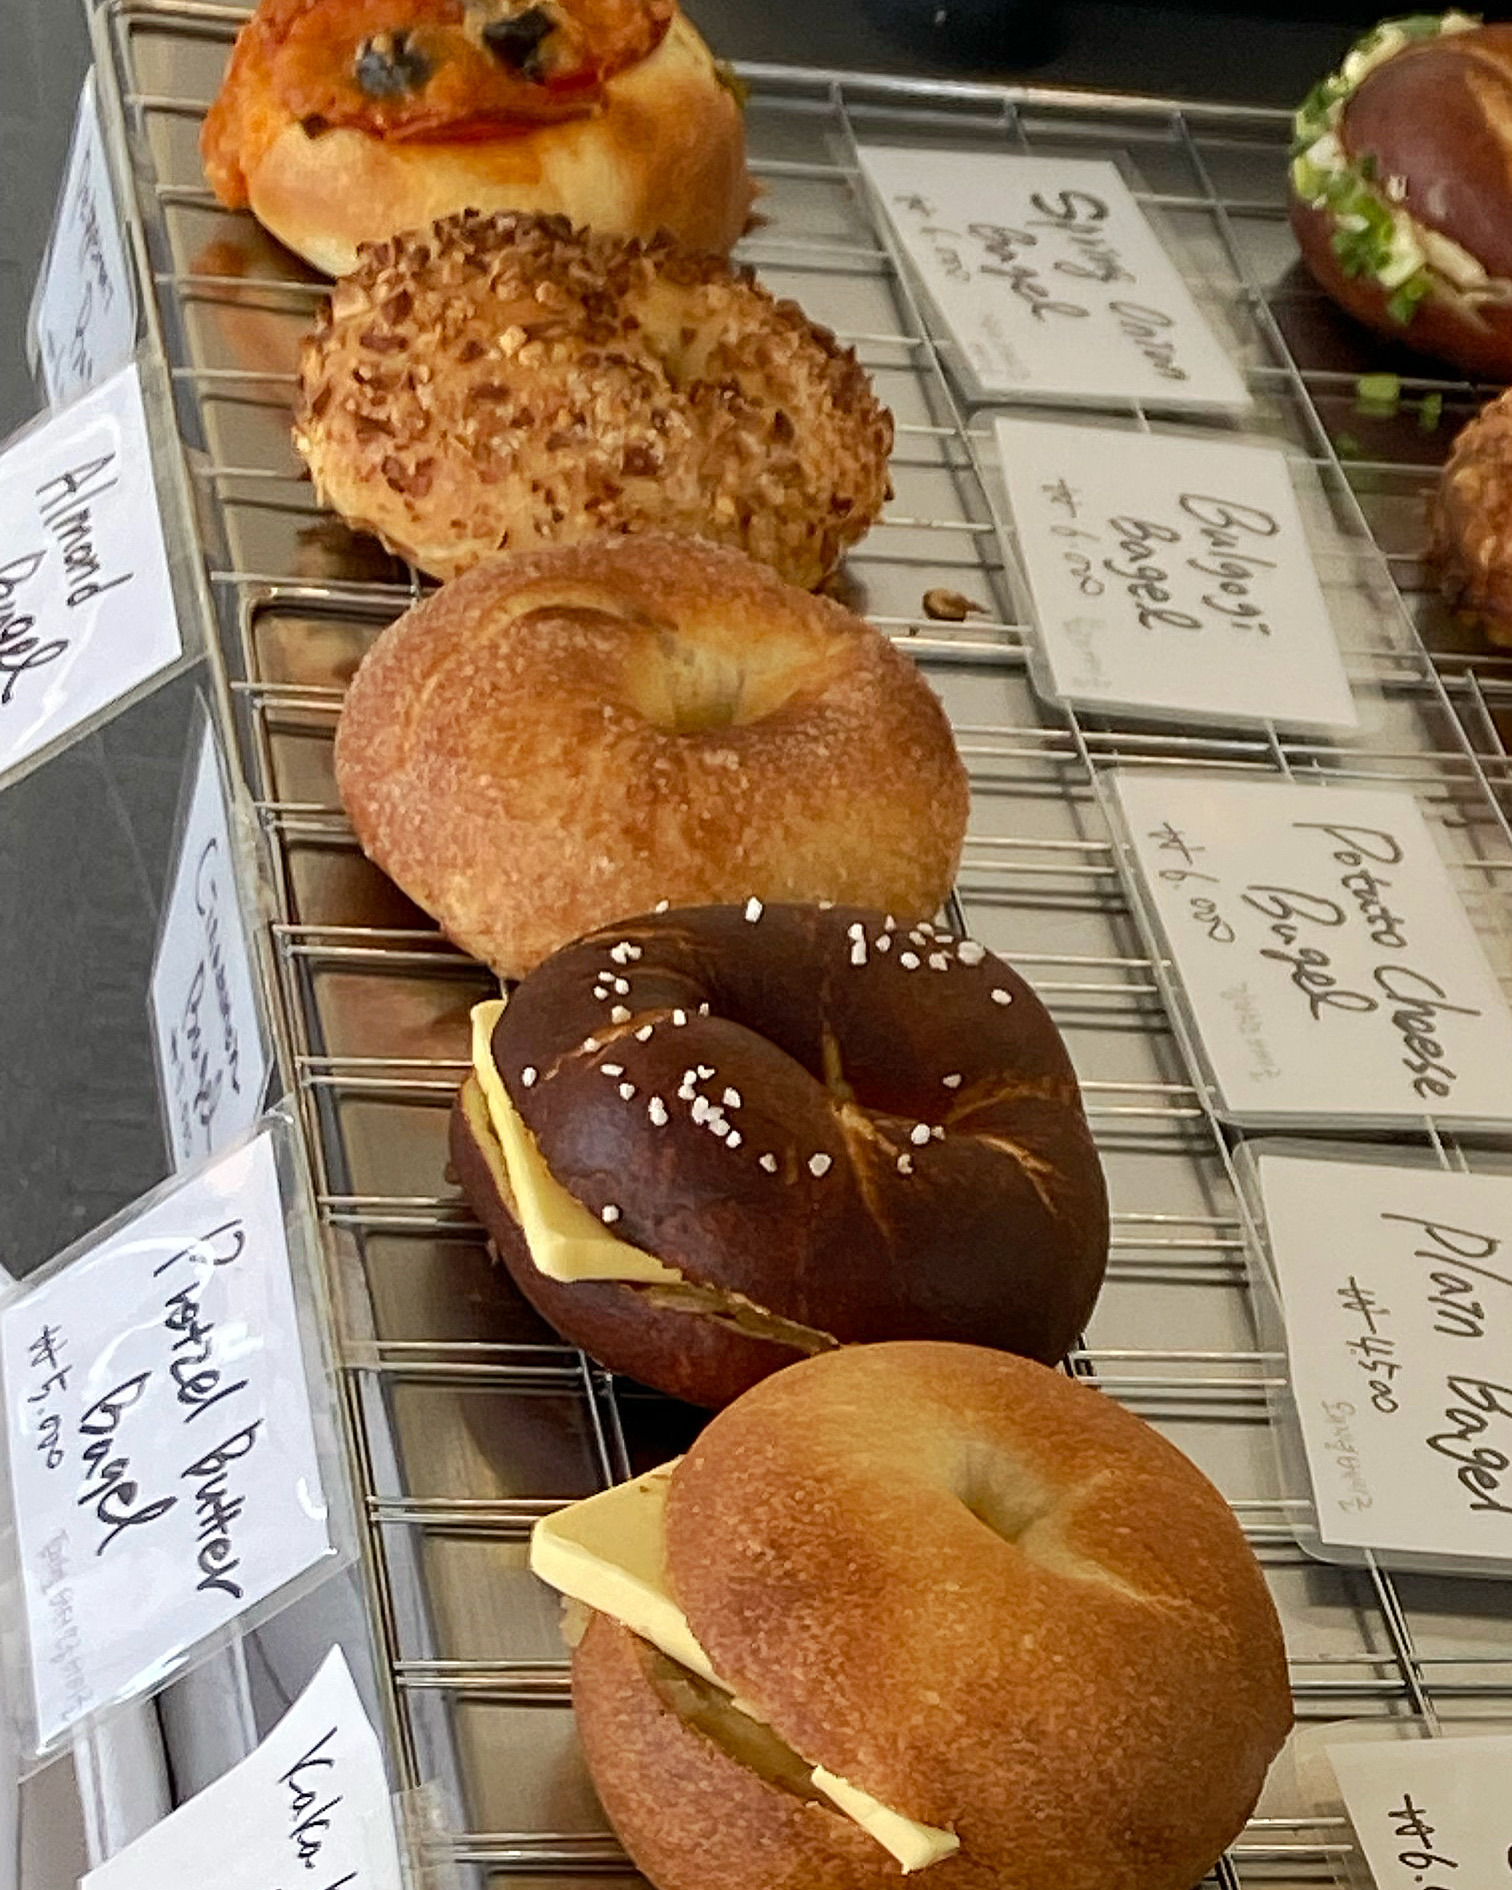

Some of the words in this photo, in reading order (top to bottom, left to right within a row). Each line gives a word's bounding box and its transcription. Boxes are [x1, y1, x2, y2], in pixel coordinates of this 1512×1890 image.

[967, 222, 1090, 323] Bagel
[35, 450, 135, 608] Almond
[1102, 515, 1204, 630] Bagel
[1178, 492, 1281, 637] Bulgogi
[1240, 884, 1379, 1021] Bagel
[1291, 822, 1409, 950] Potato
[77, 1370, 179, 1556] Bagel
[180, 1417, 265, 1600] Butter
